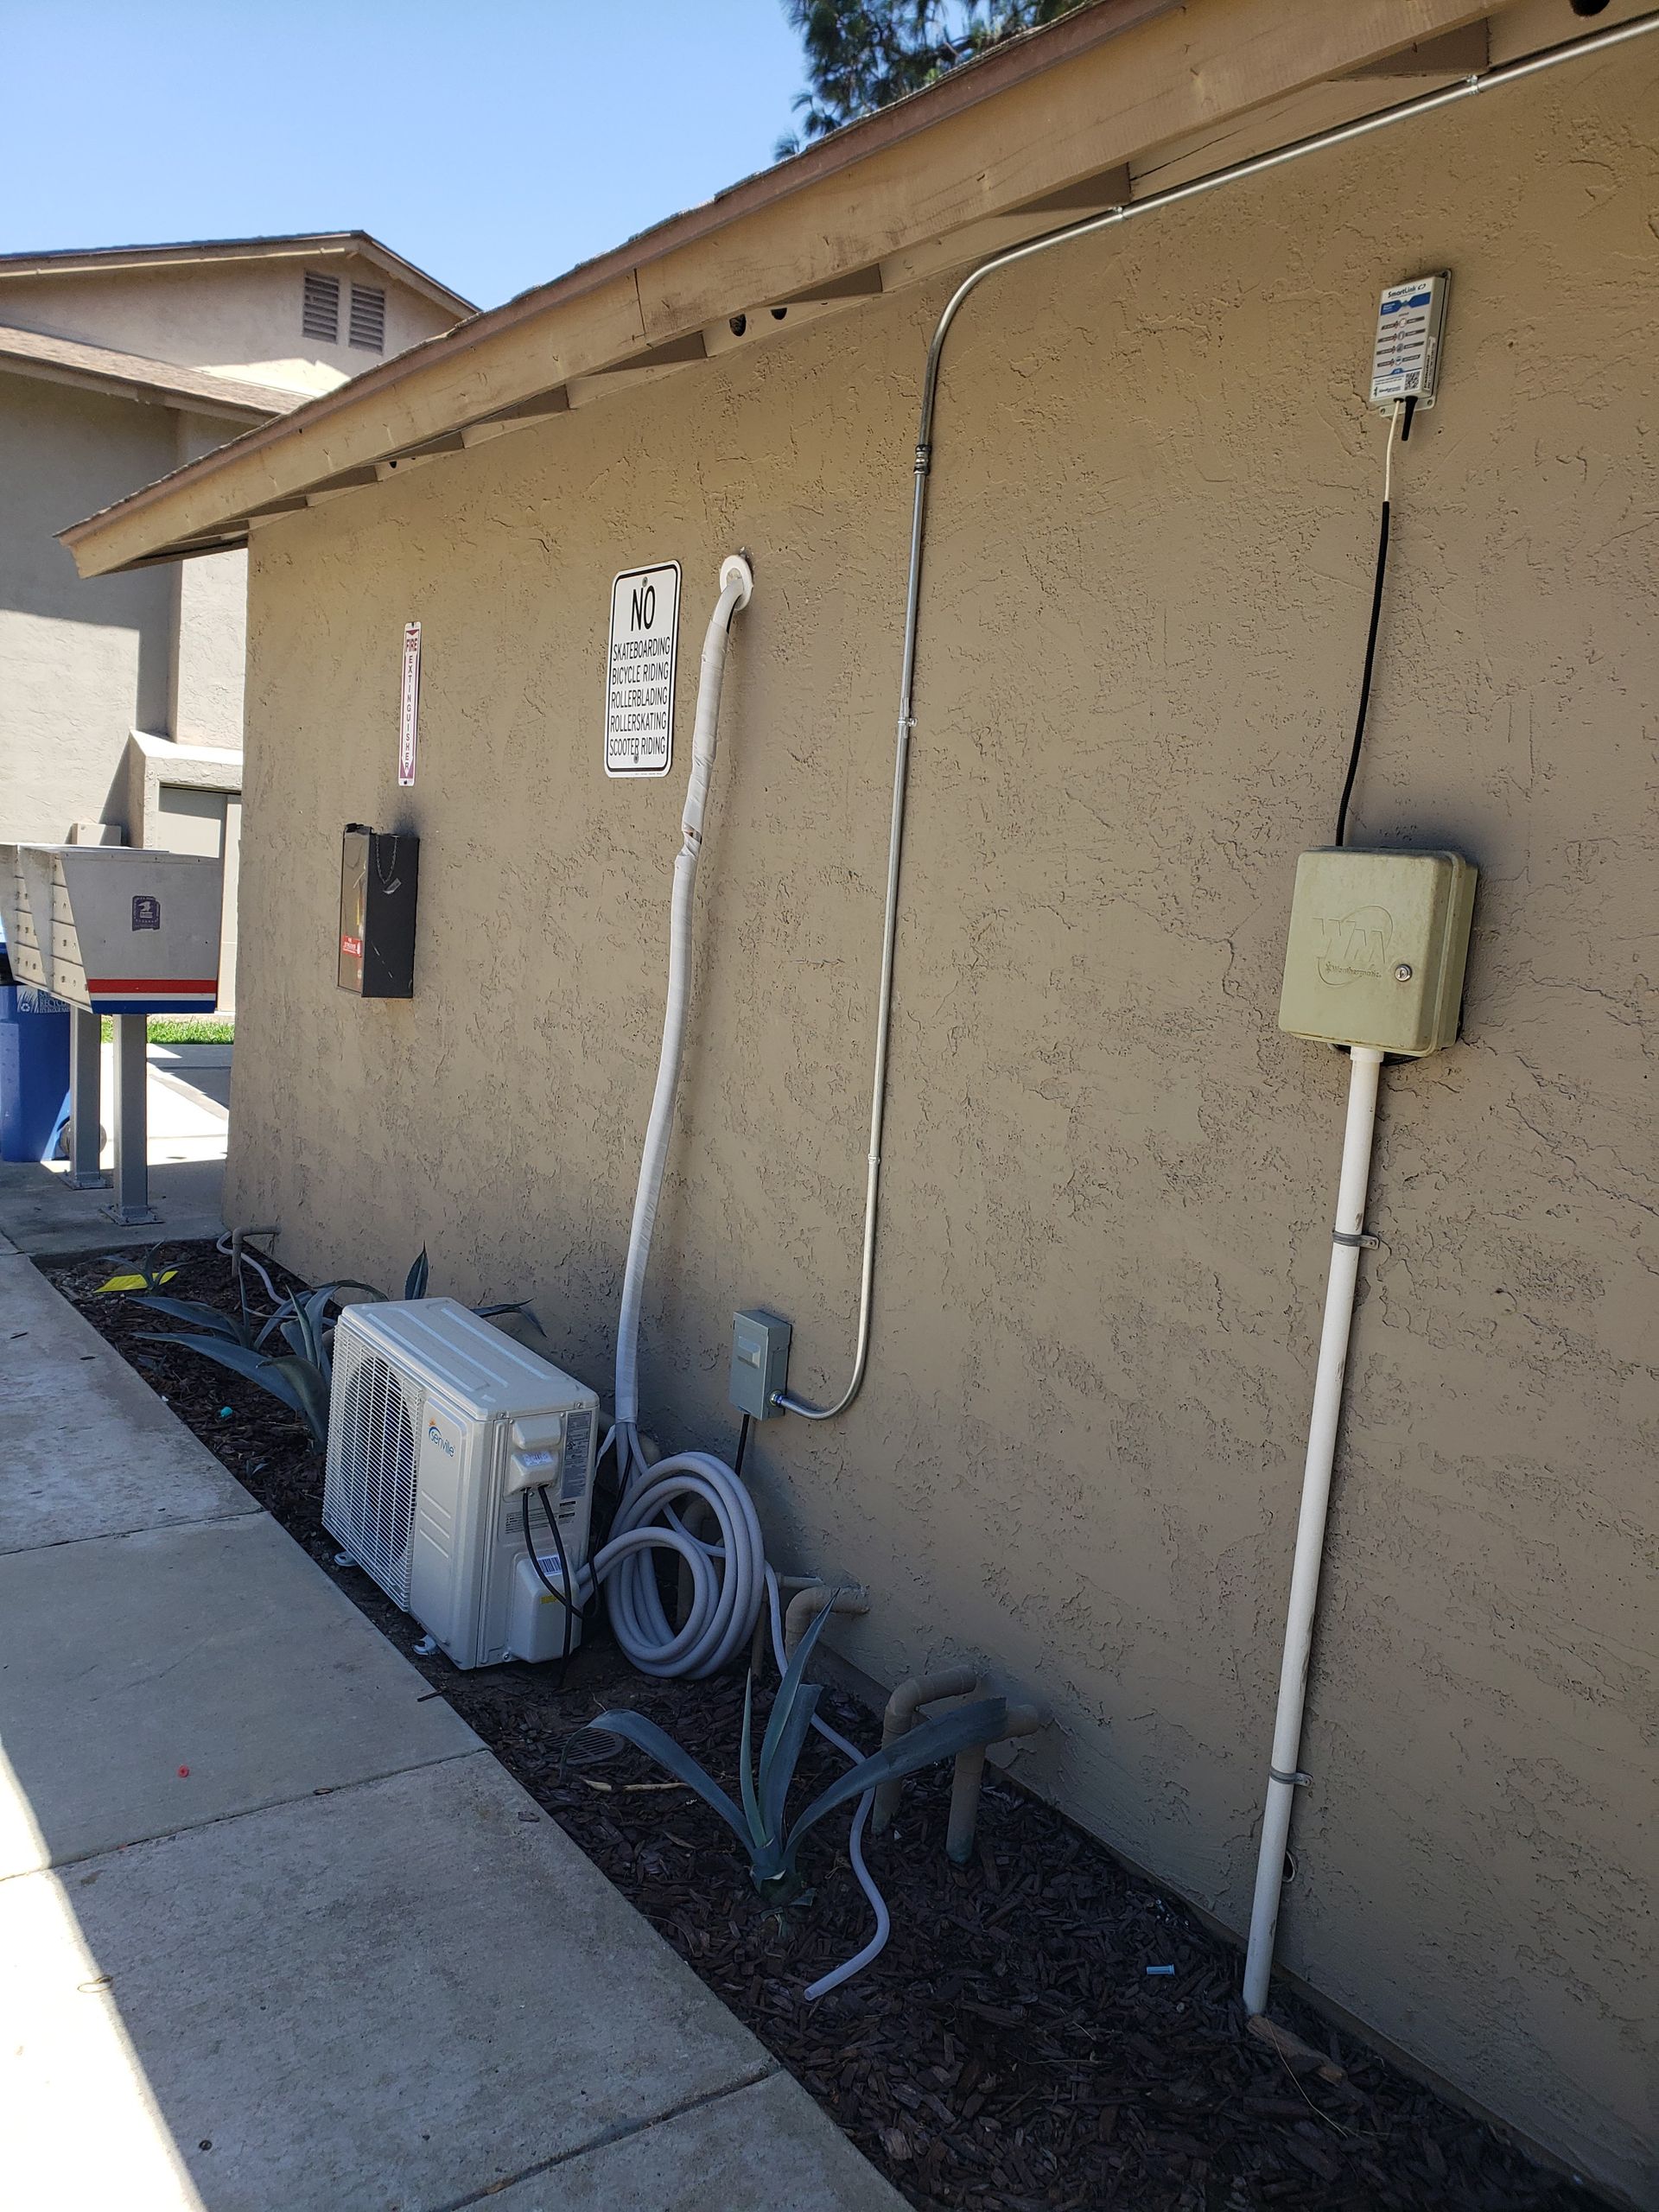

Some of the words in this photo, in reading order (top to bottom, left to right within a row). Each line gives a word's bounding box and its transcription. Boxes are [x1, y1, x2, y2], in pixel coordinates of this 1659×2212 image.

[1388, 285, 1416, 298] SmartLink
[630, 585, 656, 632] NO
[405, 638, 418, 652] FIRE
[613, 636, 671, 662] SKATEBOARDING
[612, 664, 641, 685] BICYCLE
[643, 661, 669, 682] RIDING
[611, 687, 668, 709] ROLLERBLADING
[610, 711, 667, 733] ROLLERSKATING
[609, 737, 639, 757] SCOOTER
[640, 736, 665, 755] RIDING
[430, 1431, 455, 1458] senville
